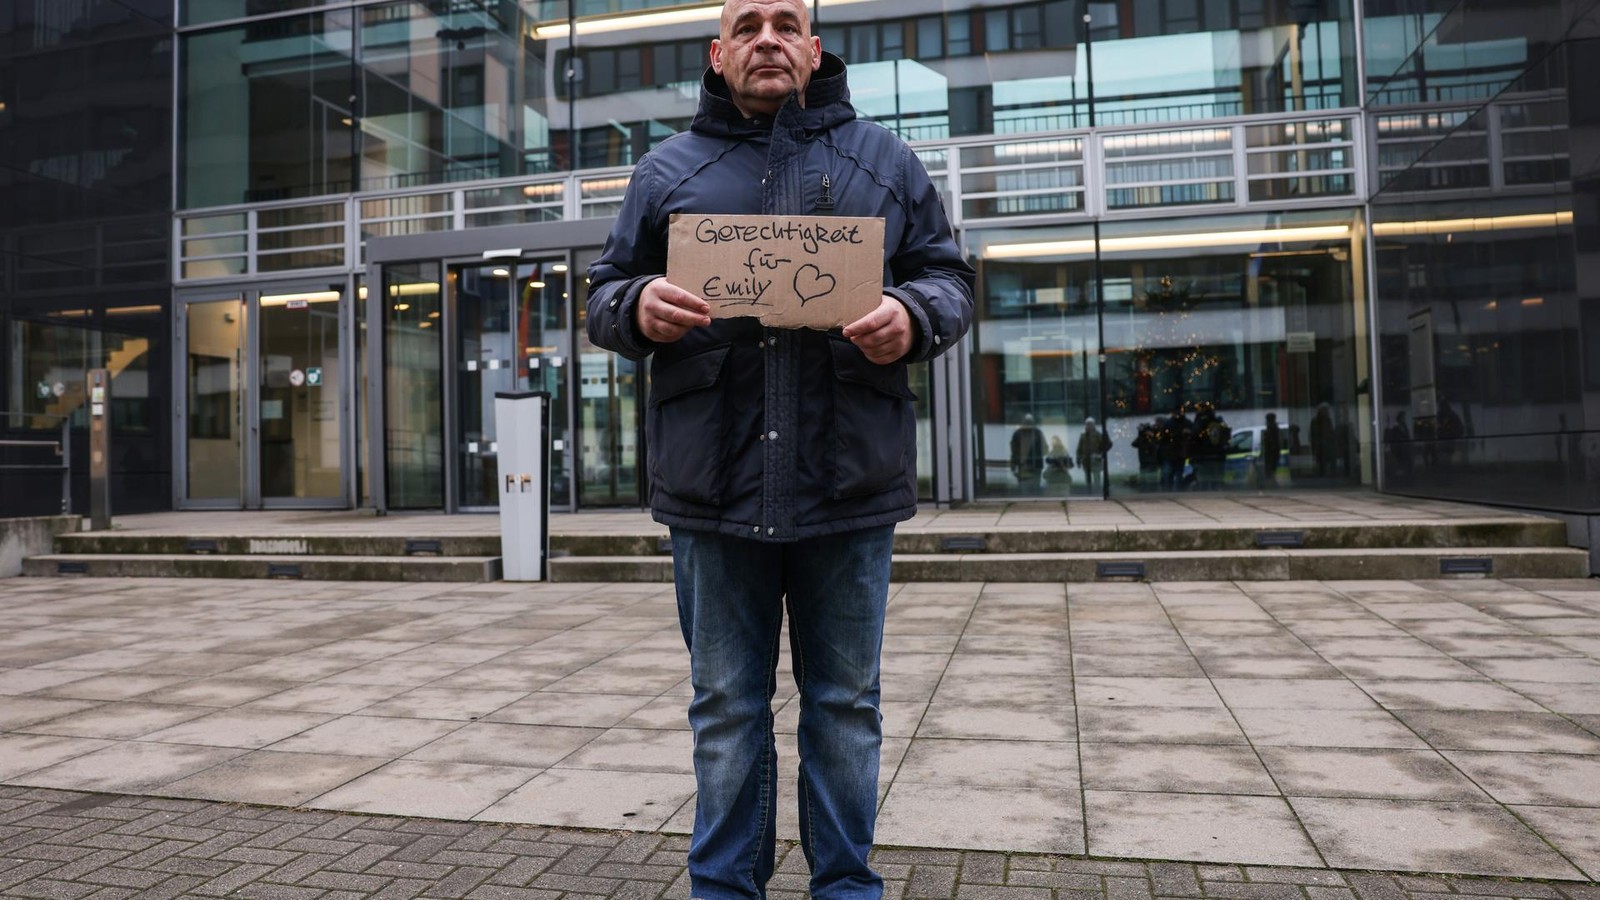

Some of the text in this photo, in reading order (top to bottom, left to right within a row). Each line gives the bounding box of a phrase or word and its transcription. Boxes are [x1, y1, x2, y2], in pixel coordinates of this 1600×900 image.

[696, 218, 863, 254] Gerechtigkeit
[743, 247, 791, 274] für
[703, 276, 772, 305] Emily
